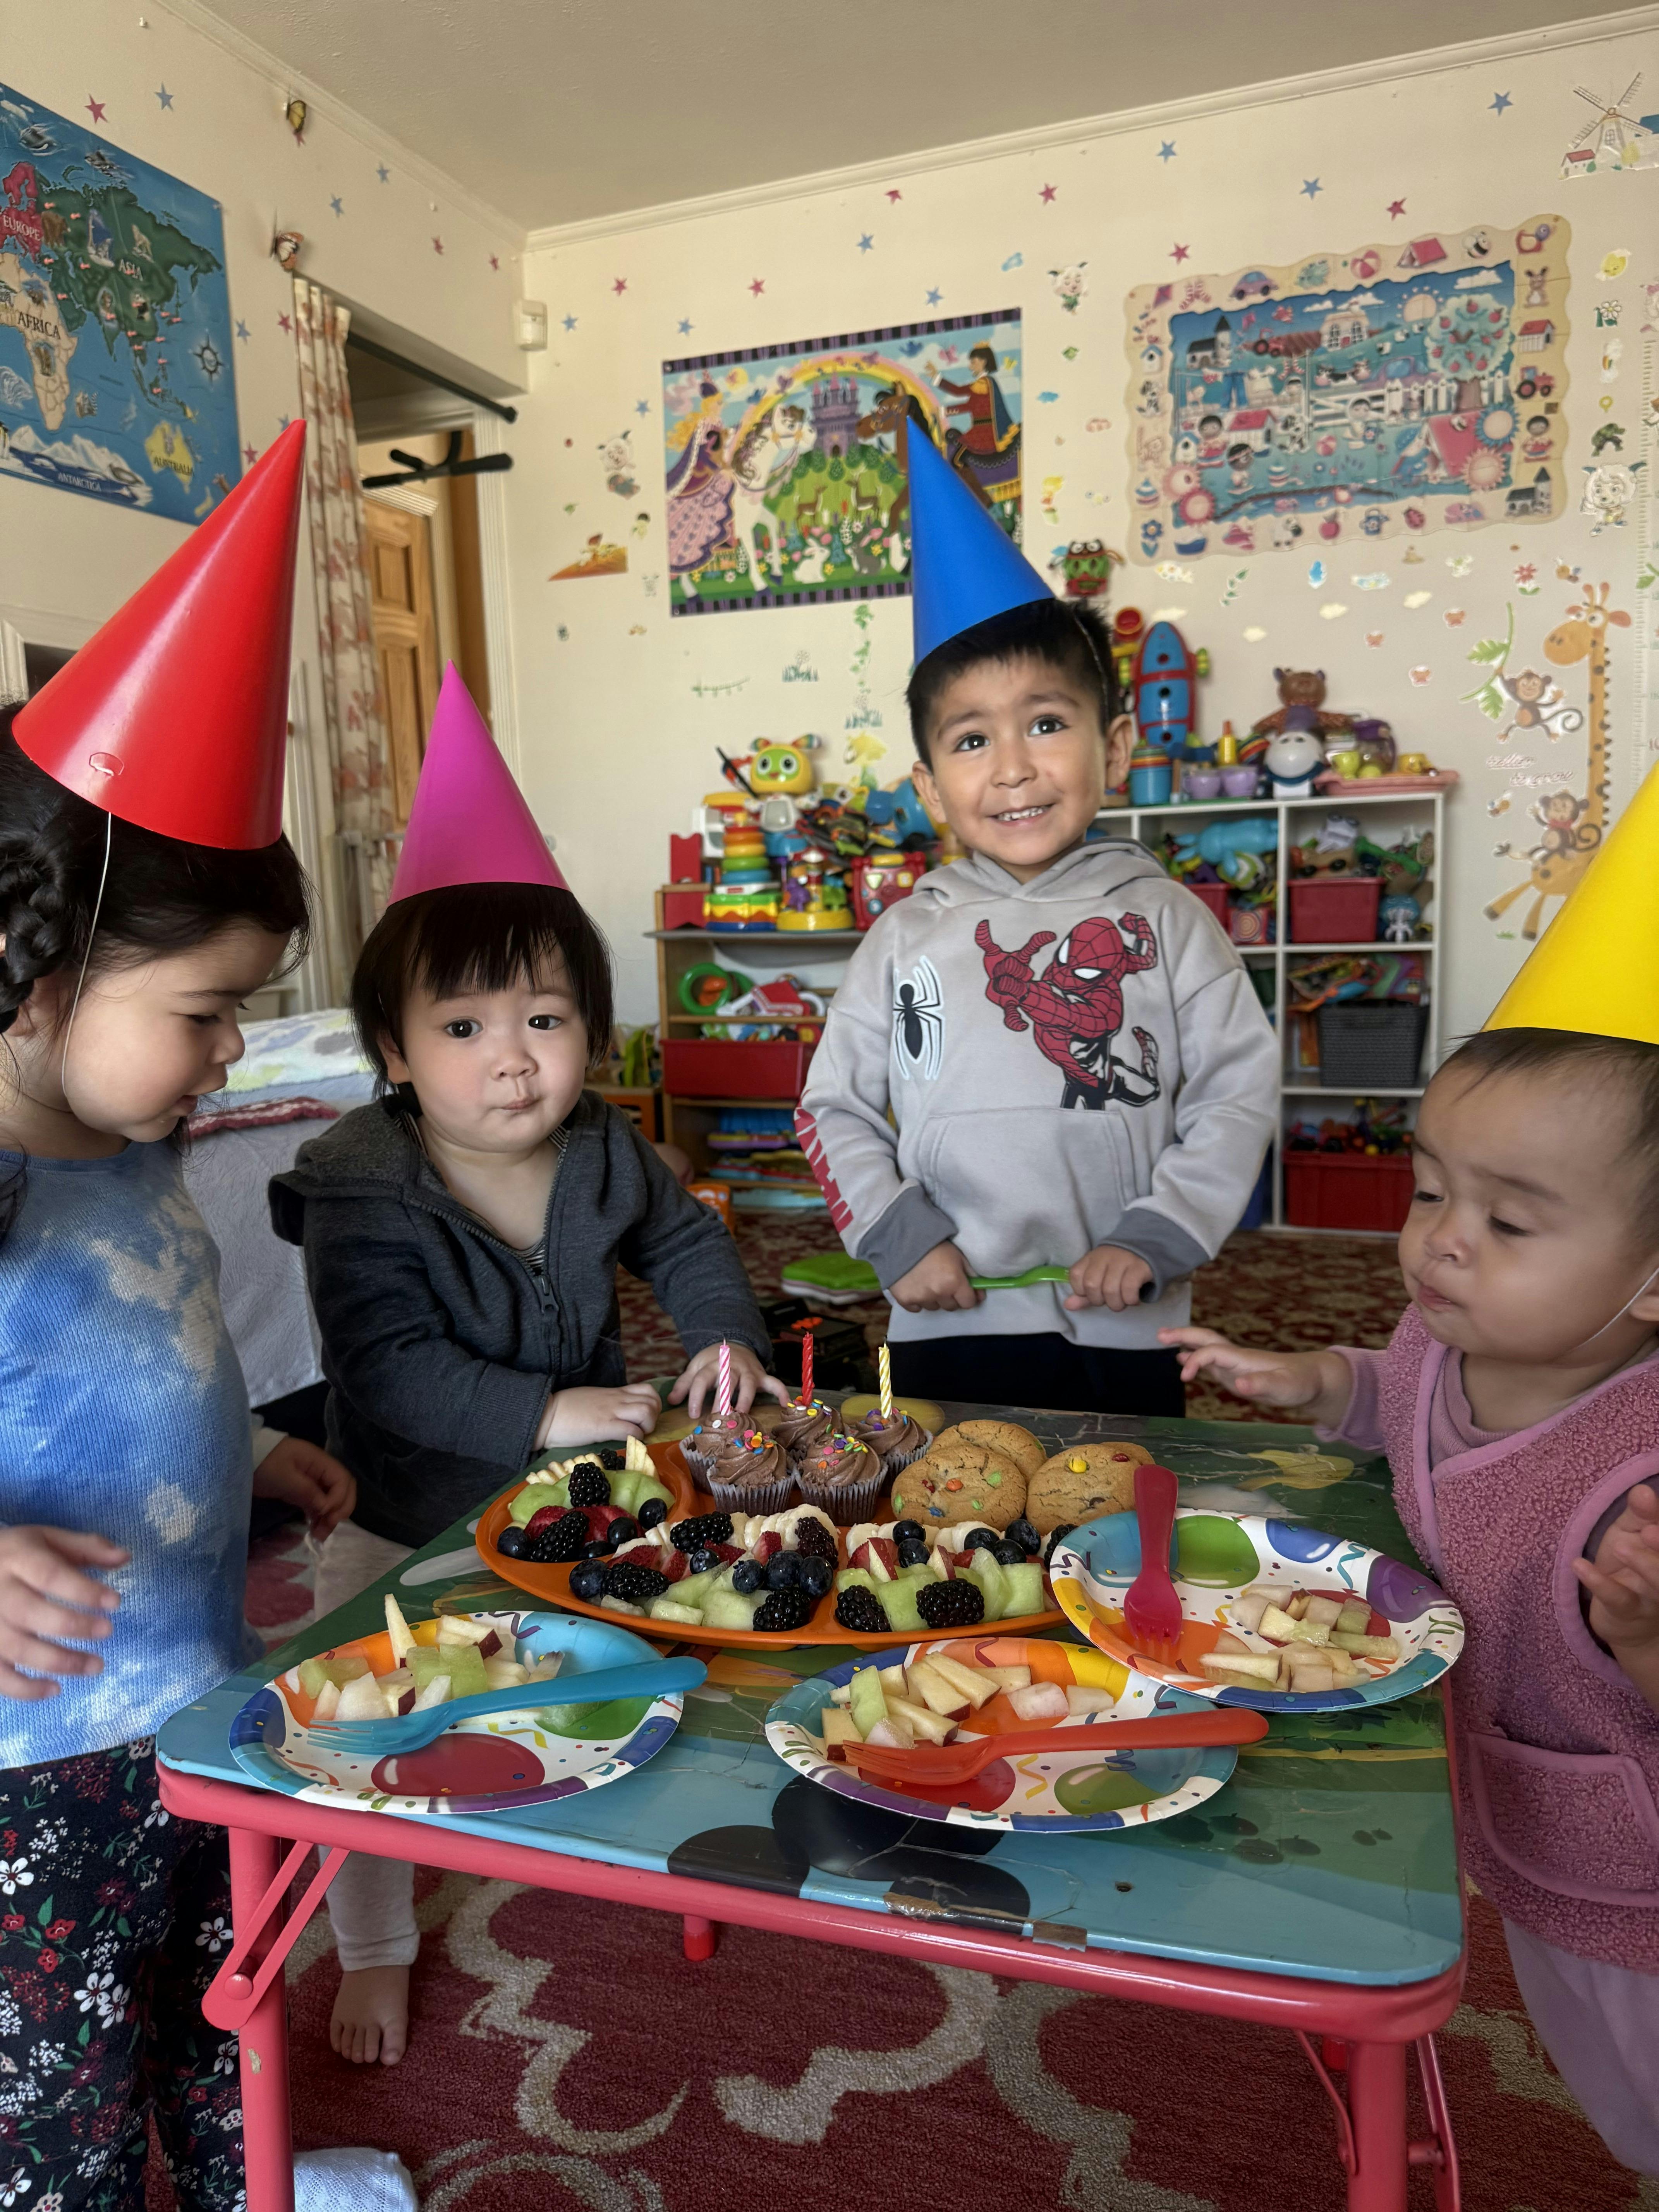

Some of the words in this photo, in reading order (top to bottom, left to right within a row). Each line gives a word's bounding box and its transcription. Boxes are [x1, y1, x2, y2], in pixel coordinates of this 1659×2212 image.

[2, 215, 40, 241] EUROPE
[118, 259, 143, 282] ASIA
[18, 311, 61, 340] AFRICA
[154, 456, 196, 478] AUSTRALIA
[58, 472, 101, 492] ANTARCTICA
